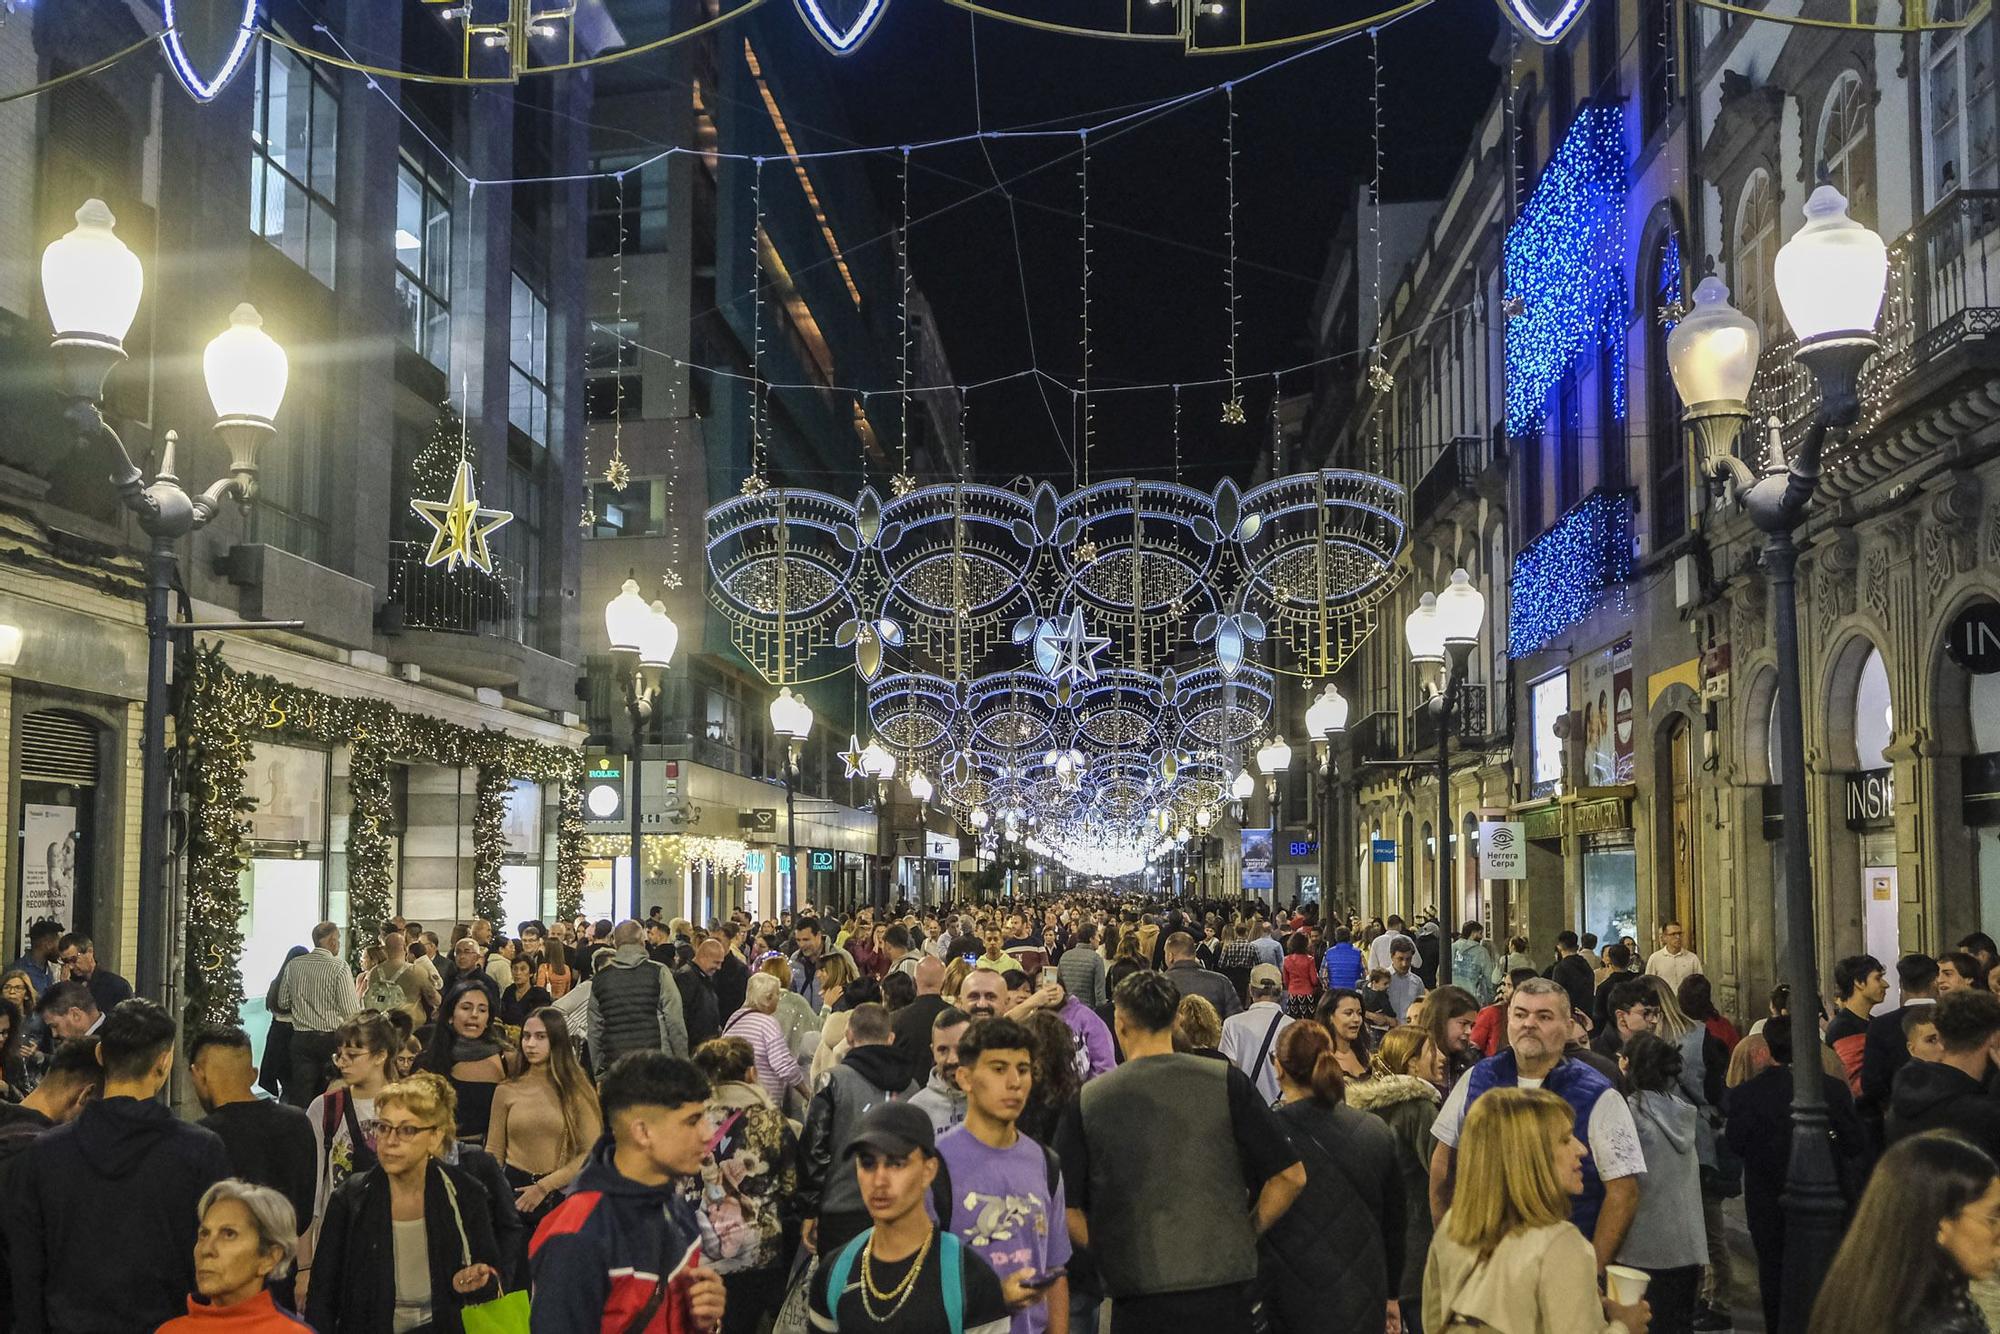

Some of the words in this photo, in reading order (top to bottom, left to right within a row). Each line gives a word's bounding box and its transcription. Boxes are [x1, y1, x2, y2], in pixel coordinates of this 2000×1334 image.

[588, 769, 620, 778] ROLEX
[1491, 860, 1515, 868] Cerpa
[29, 889, 62, 899] COMPENSA
[26, 900, 66, 909] RECOMPENSA
